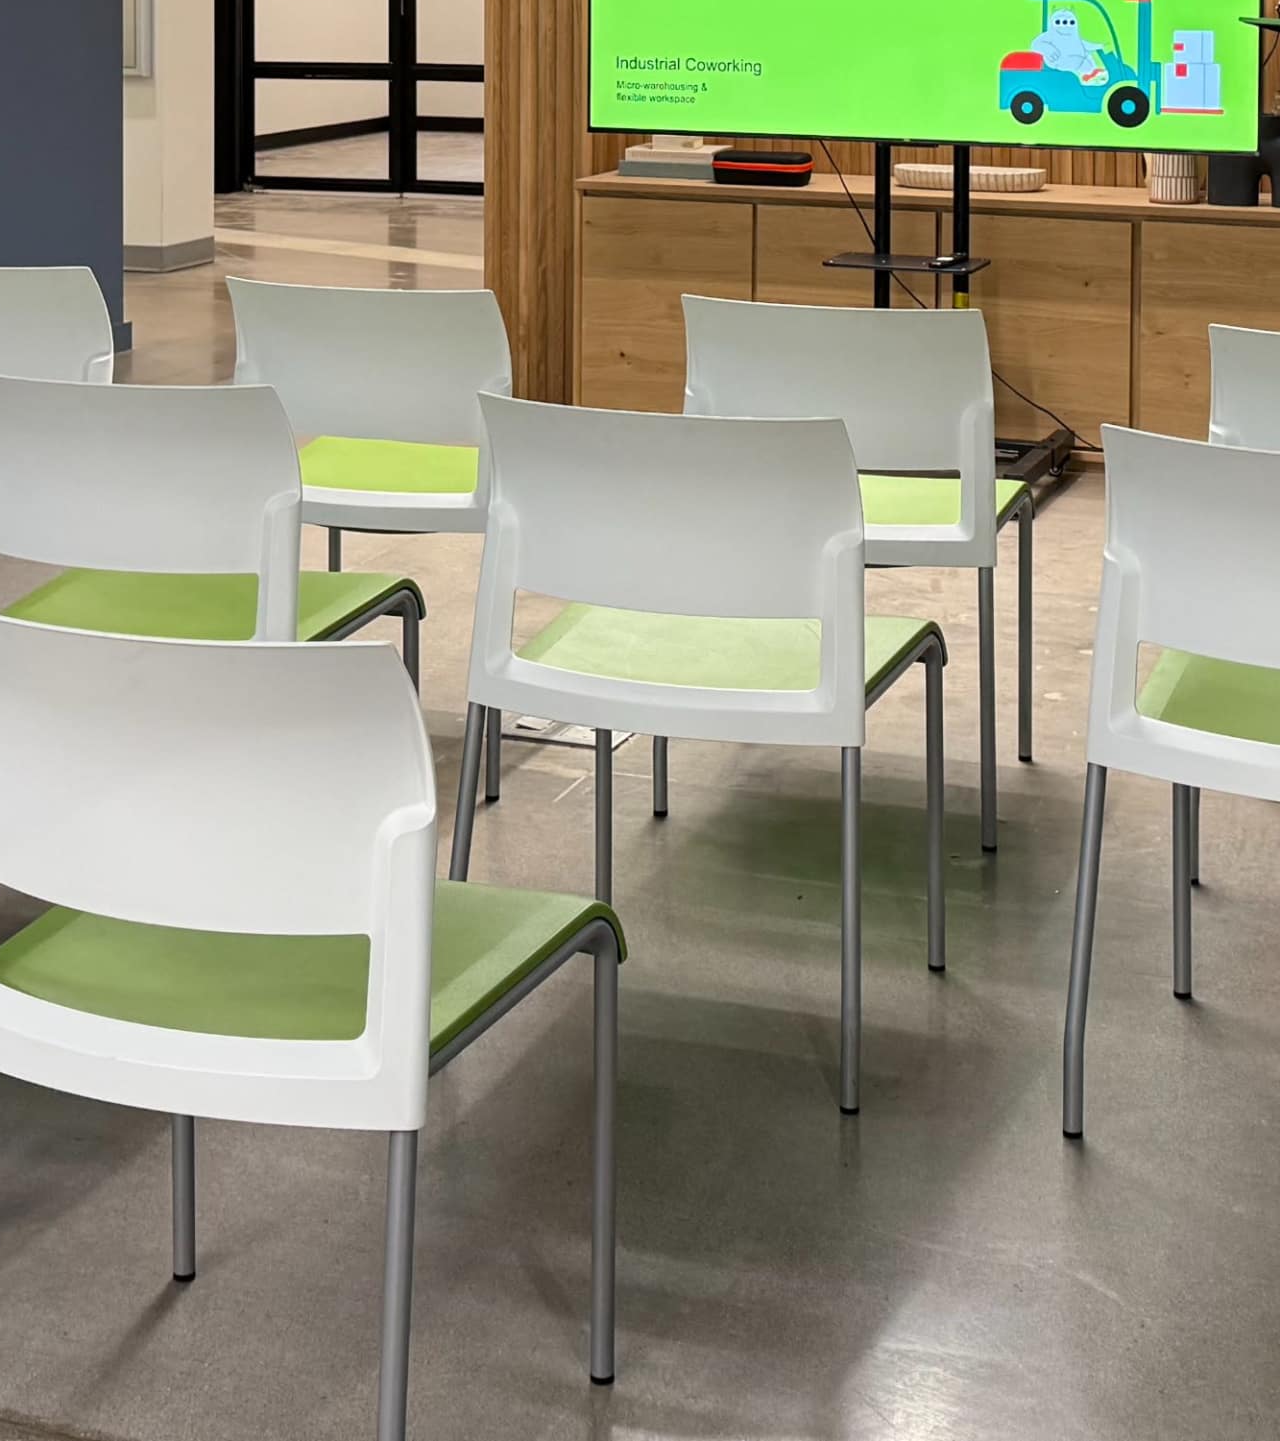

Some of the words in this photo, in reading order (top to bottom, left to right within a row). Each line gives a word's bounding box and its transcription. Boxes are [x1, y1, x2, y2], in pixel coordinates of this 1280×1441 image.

[616, 56, 680, 70] Industrial
[685, 57, 762, 76] Coworking
[701, 82, 708, 91] &
[649, 94, 696, 104] workspace
